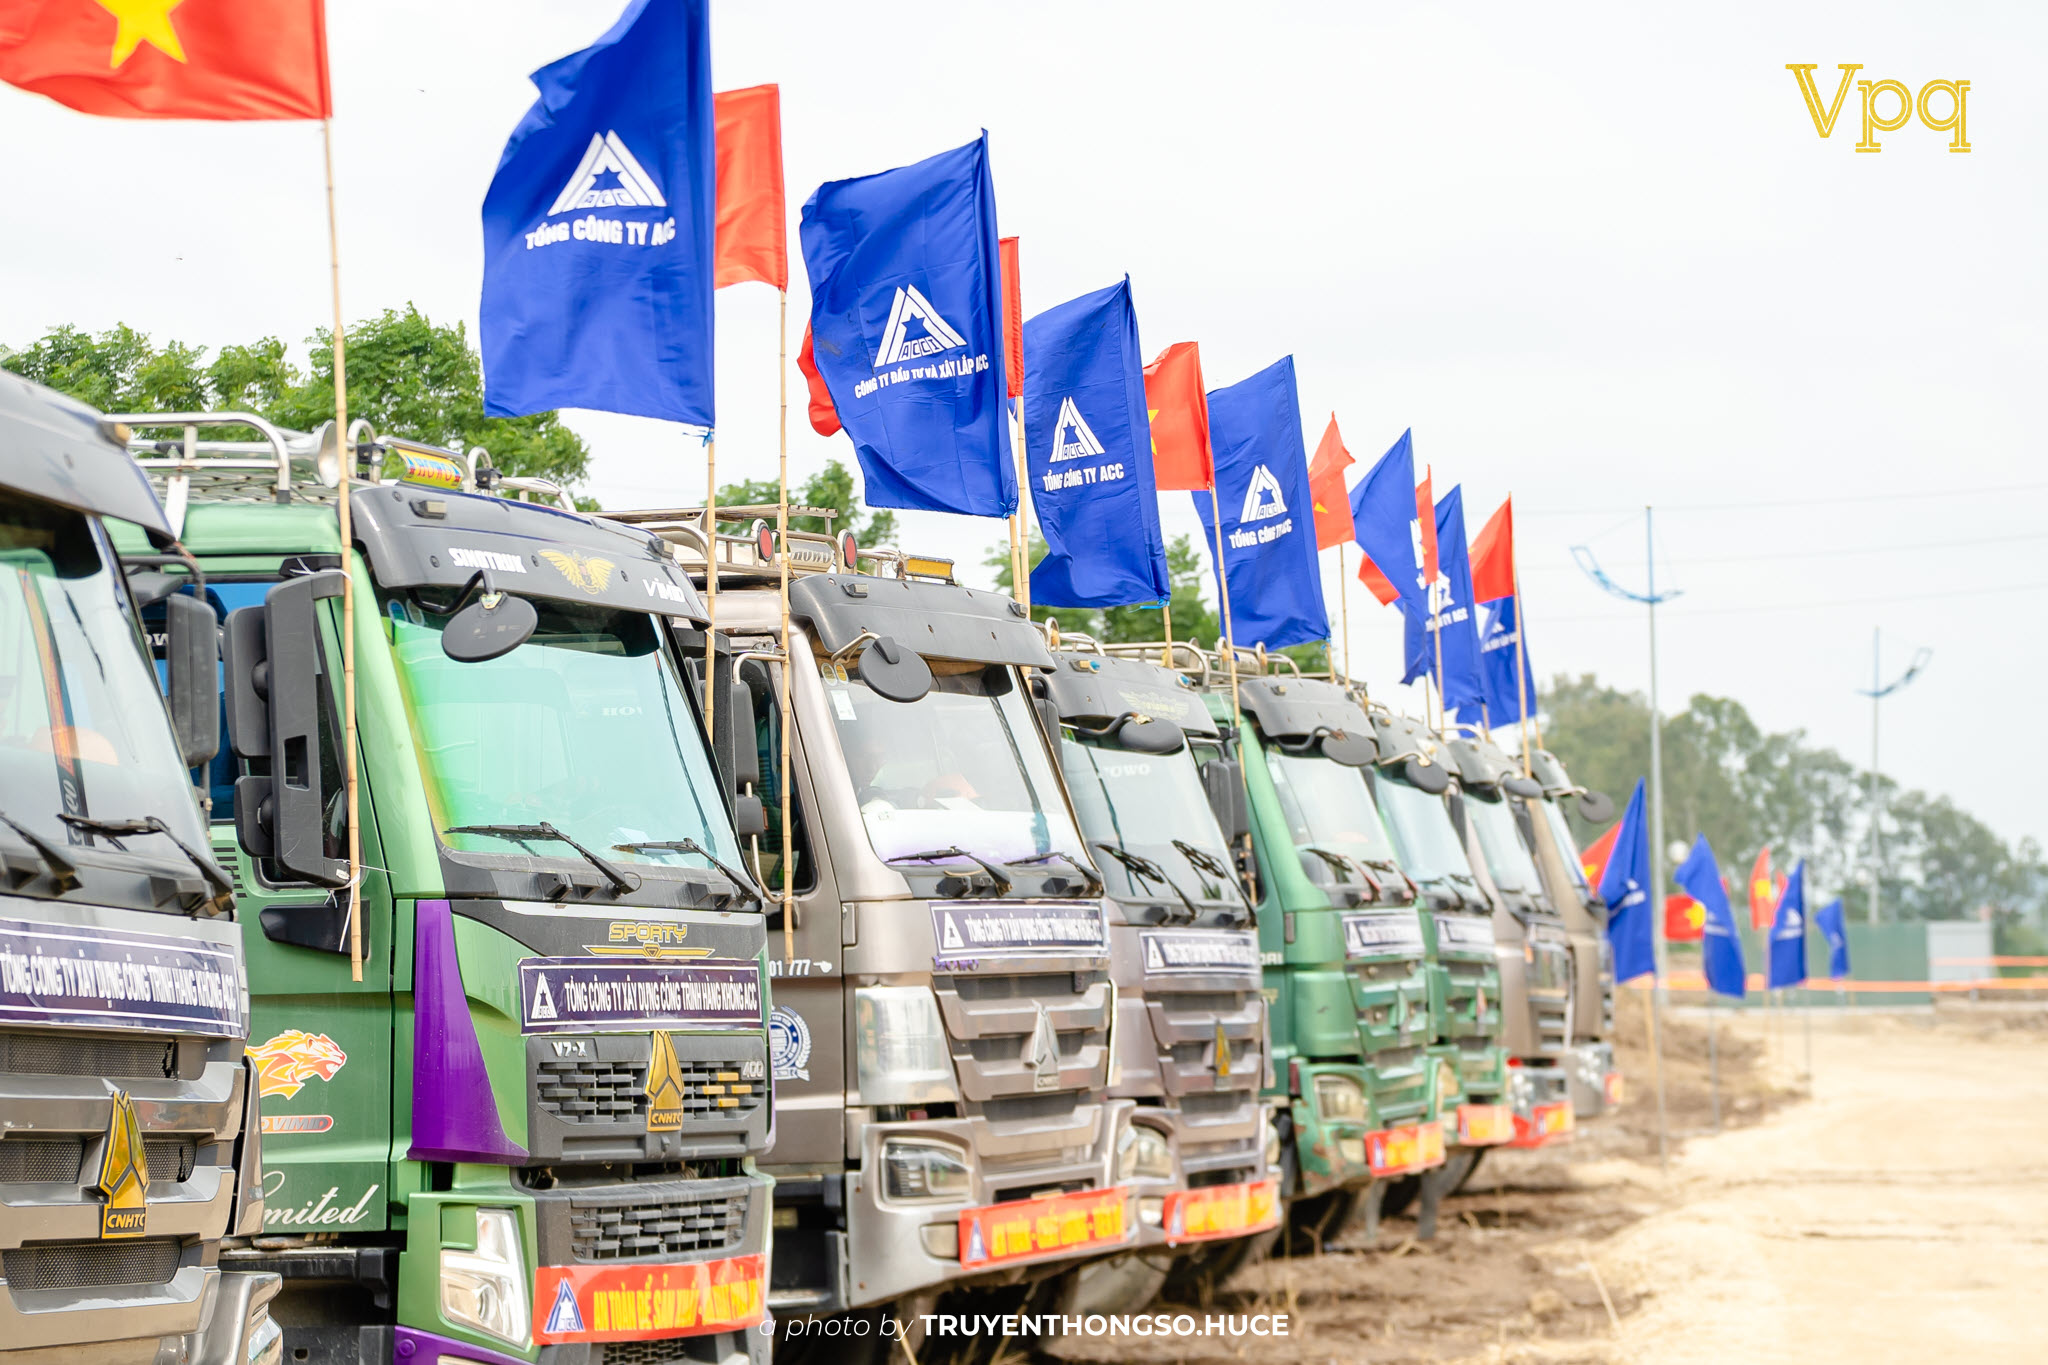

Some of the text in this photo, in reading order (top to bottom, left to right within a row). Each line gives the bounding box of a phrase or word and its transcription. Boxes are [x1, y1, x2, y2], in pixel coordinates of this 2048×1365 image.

[573, 214, 623, 244] CÔNG
[626, 221, 648, 246] TY
[901, 338, 942, 360] ACCI
[854, 377, 879, 399] CÔNG
[878, 372, 889, 389] TY
[911, 367, 924, 380] TƯ
[925, 364, 939, 378] VÀ
[939, 360, 956, 379] XÂY
[956, 354, 975, 376] LẮP
[1042, 463, 1124, 492] TỔNG CÔNG TY ACC
[1228, 528, 1258, 549] TỔNG
[448, 547, 527, 573] SINOTRUK
[609, 921, 687, 943] SPORTY
[30, 945, 64, 996] CÔNG
[60, 957, 77, 996] TY
[74, 949, 97, 997] XÂY
[122, 953, 151, 1002] CÔNG
[788, 959, 811, 976] 777
[564, 975, 588, 1012] TỔNG
[588, 974, 612, 1012] CÔNG
[611, 982, 622, 1011] TY
[622, 974, 638, 1011] XÂY
[660, 974, 682, 1011] CÔNG
[743, 982, 757, 1011] ACC
[552, 1041, 587, 1057] V7-X
[743, 1061, 764, 1077] 400
[273, 1116, 329, 1131] VIMID
[652, 1112, 682, 1124] CNHTC
[106, 1212, 145, 1229] CNHTC
